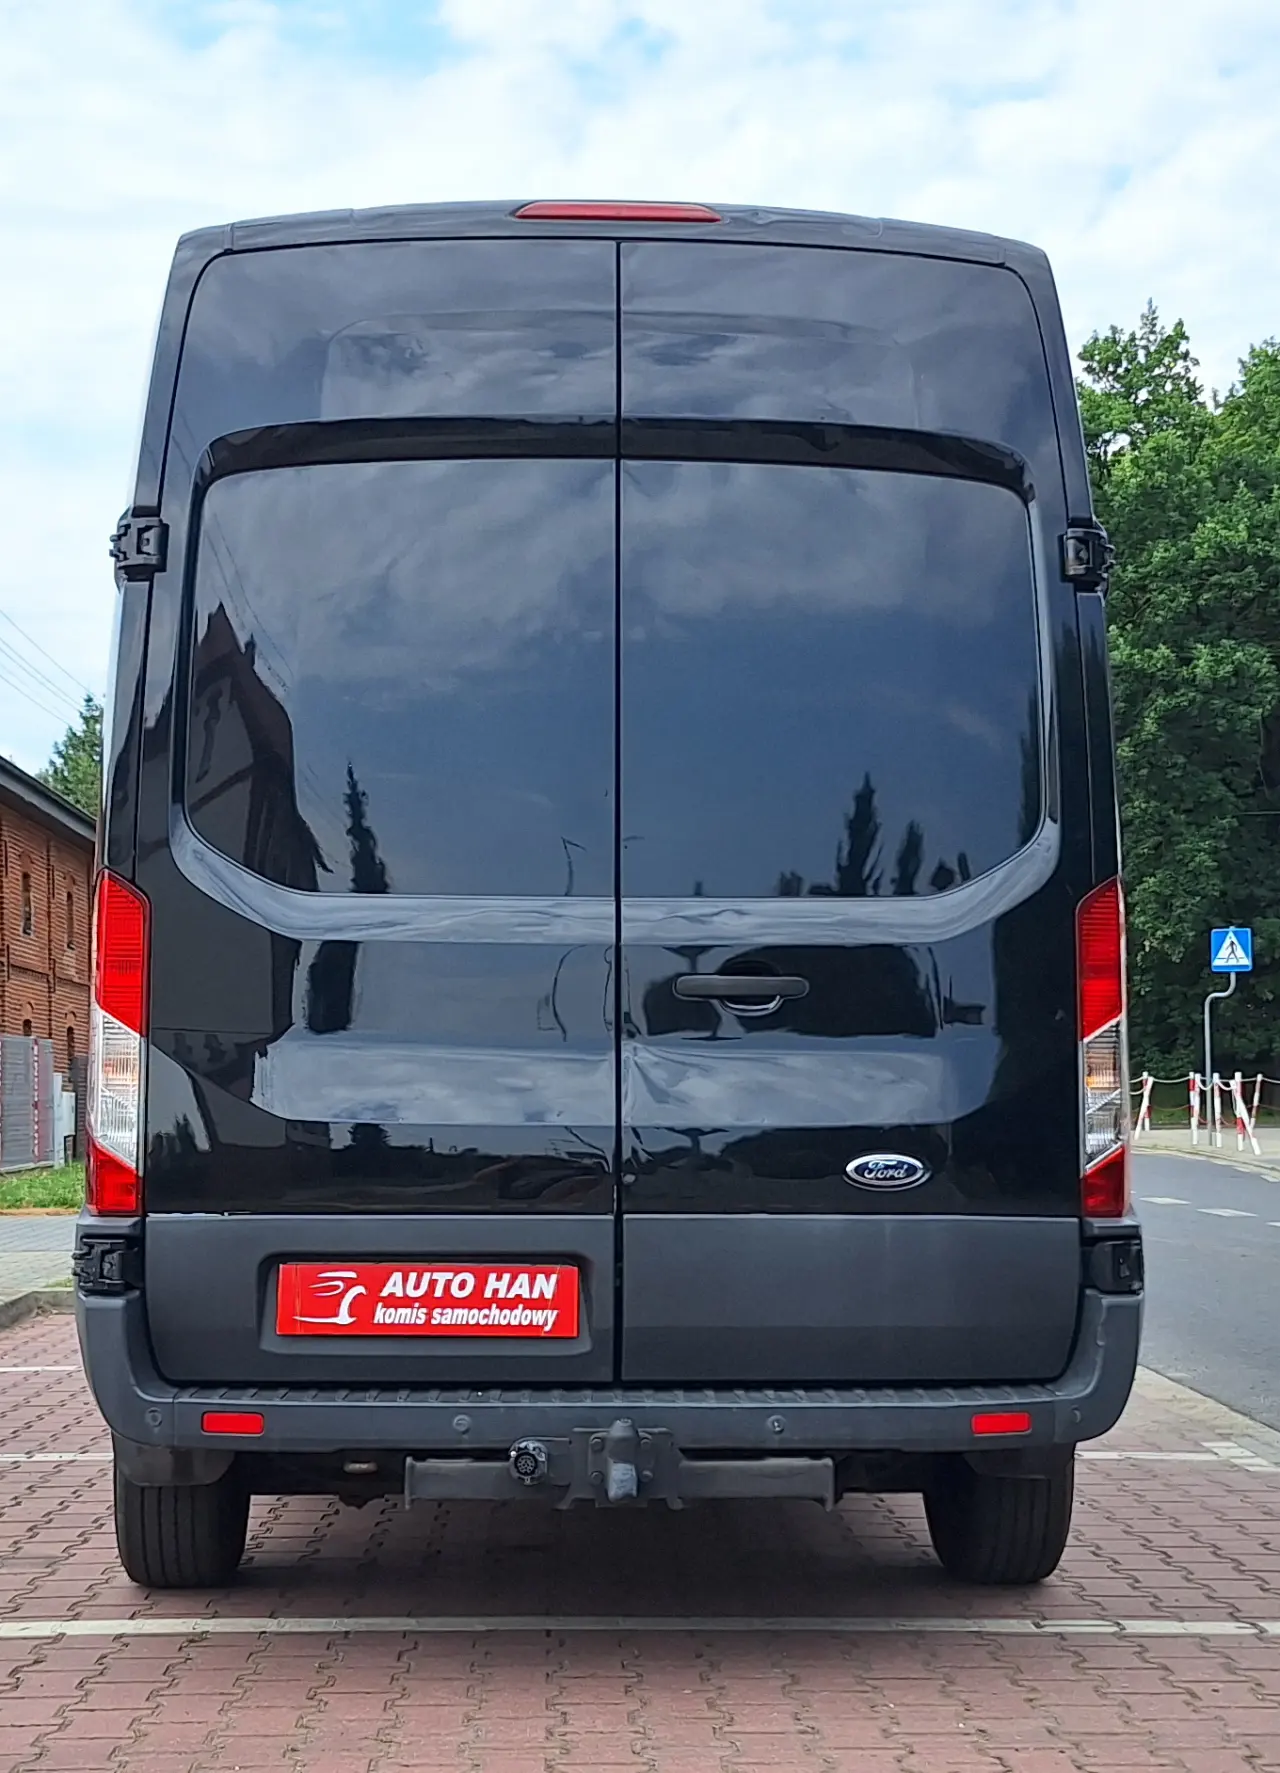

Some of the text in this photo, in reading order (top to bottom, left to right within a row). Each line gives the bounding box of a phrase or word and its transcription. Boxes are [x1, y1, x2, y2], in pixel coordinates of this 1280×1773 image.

[863, 1160, 909, 1179] Ford
[380, 1271, 558, 1300] AUTO HAN
[373, 1302, 558, 1332] komis samochodowy
